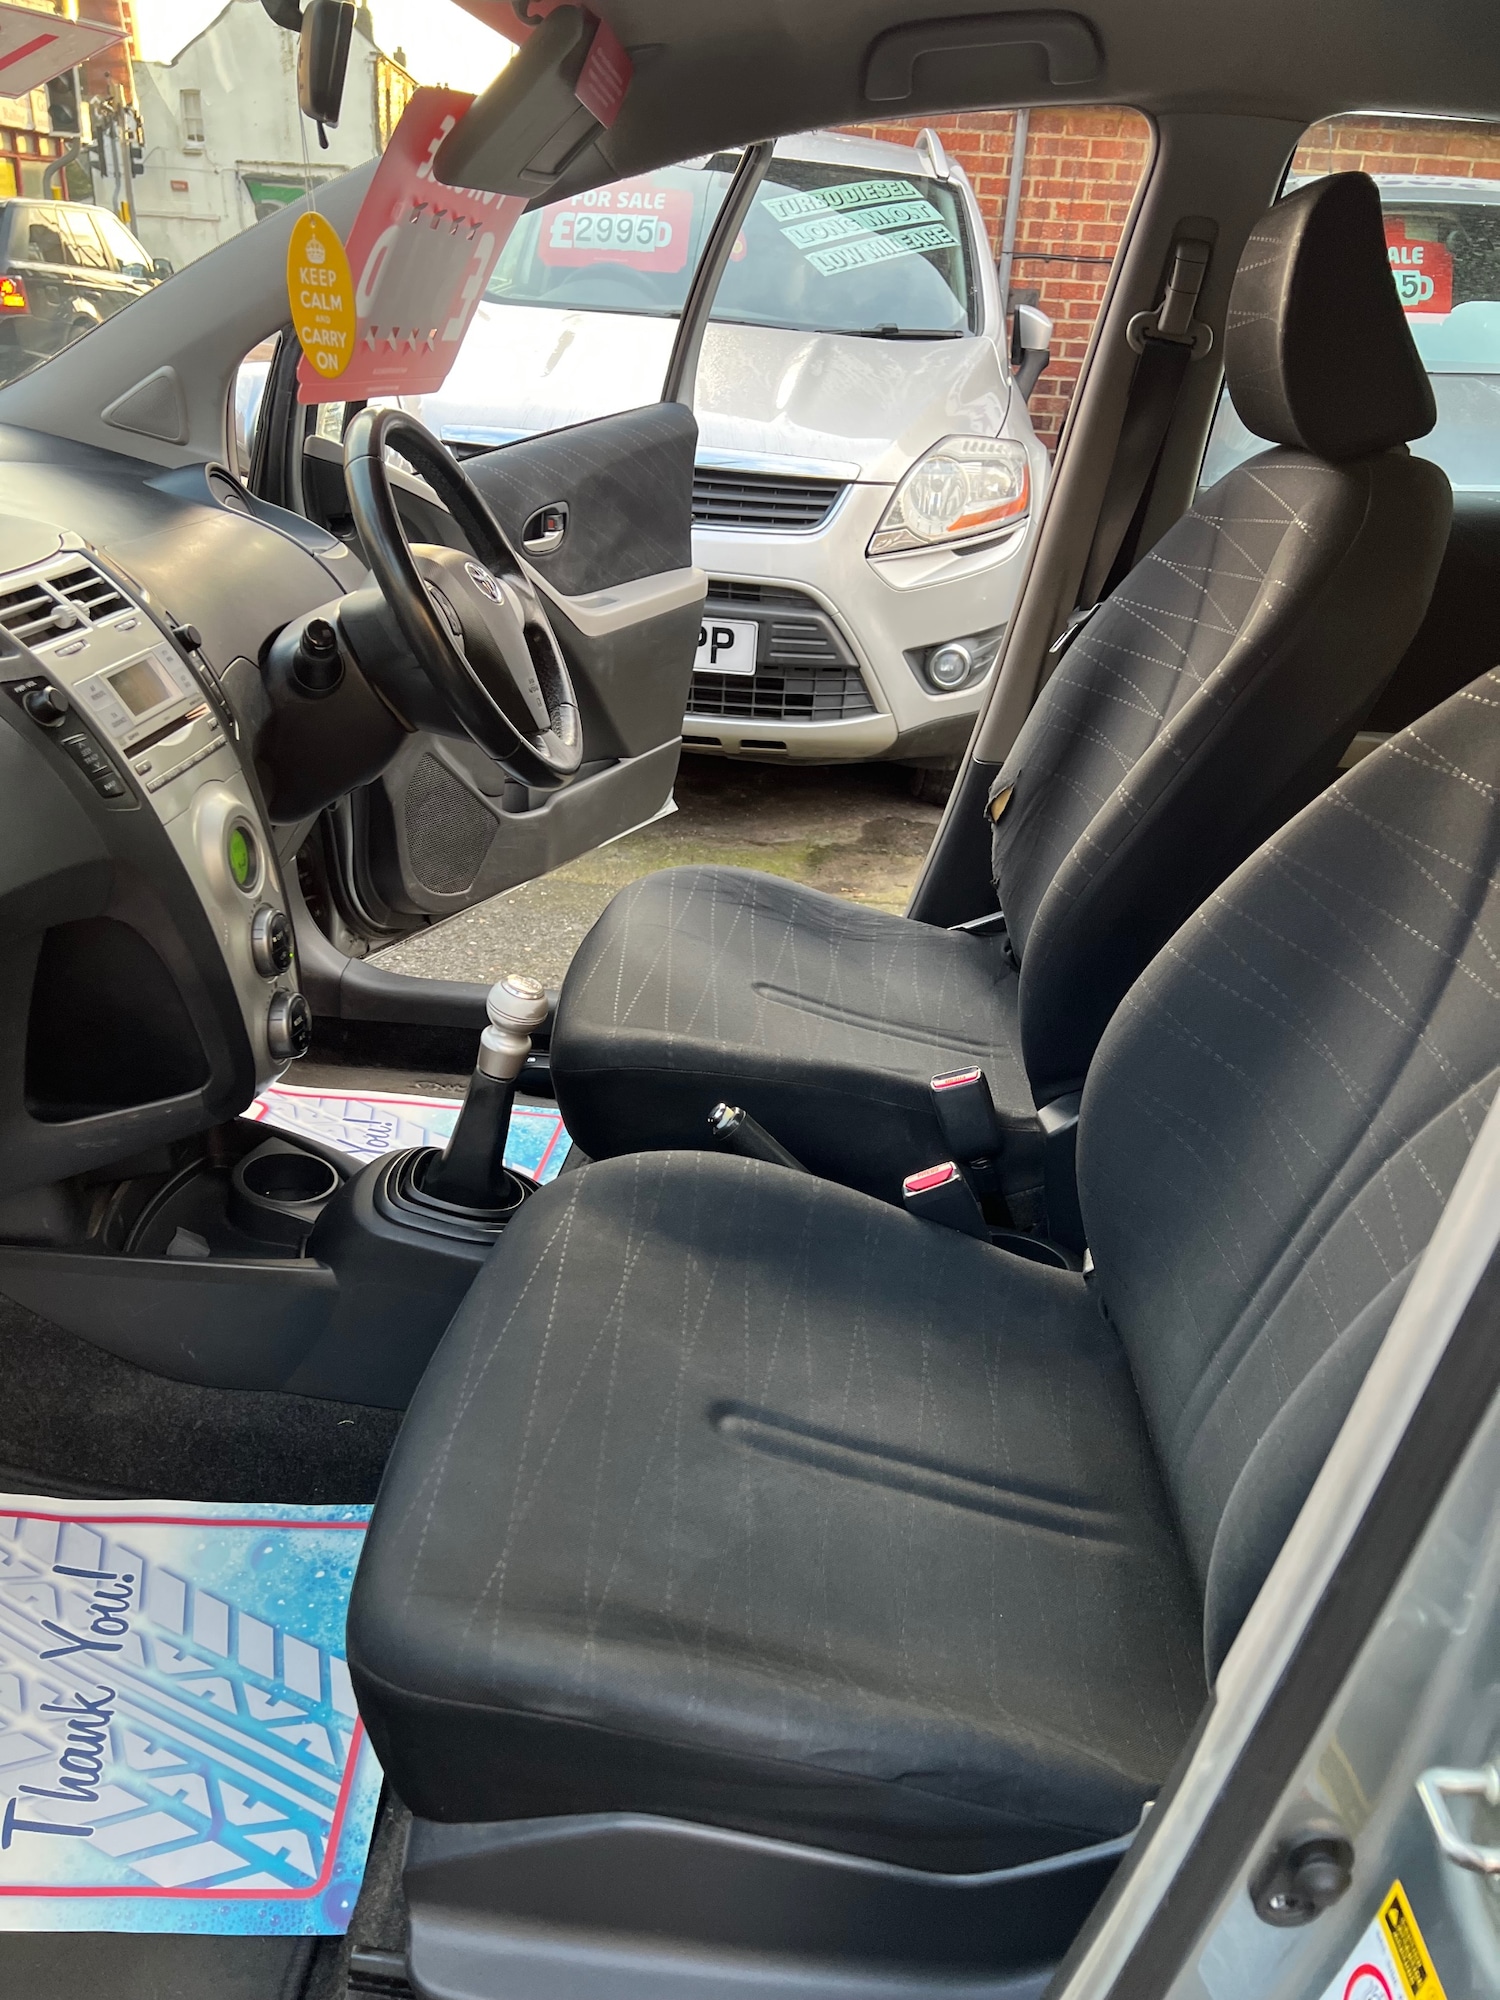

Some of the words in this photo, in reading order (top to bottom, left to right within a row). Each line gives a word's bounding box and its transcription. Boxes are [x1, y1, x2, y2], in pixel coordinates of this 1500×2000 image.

[571, 190, 612, 207] FOR
[616, 191, 667, 209] SALE
[769, 191, 845, 217] TURBO
[841, 181, 917, 204] DIESEL
[789, 215, 863, 243] LONG
[859, 203, 932, 228] M.O.T
[814, 248, 865, 272] LOW
[862, 227, 956, 259] MILEAGE
[299, 267, 337, 287] KEEP
[300, 291, 343, 312] CALM
[315, 315, 331, 325] AND
[302, 326, 347, 349] CARRY
[316, 351, 339, 371] ON
[39, 1564, 135, 1660] You!
[1, 1685, 116, 1850] Thank
